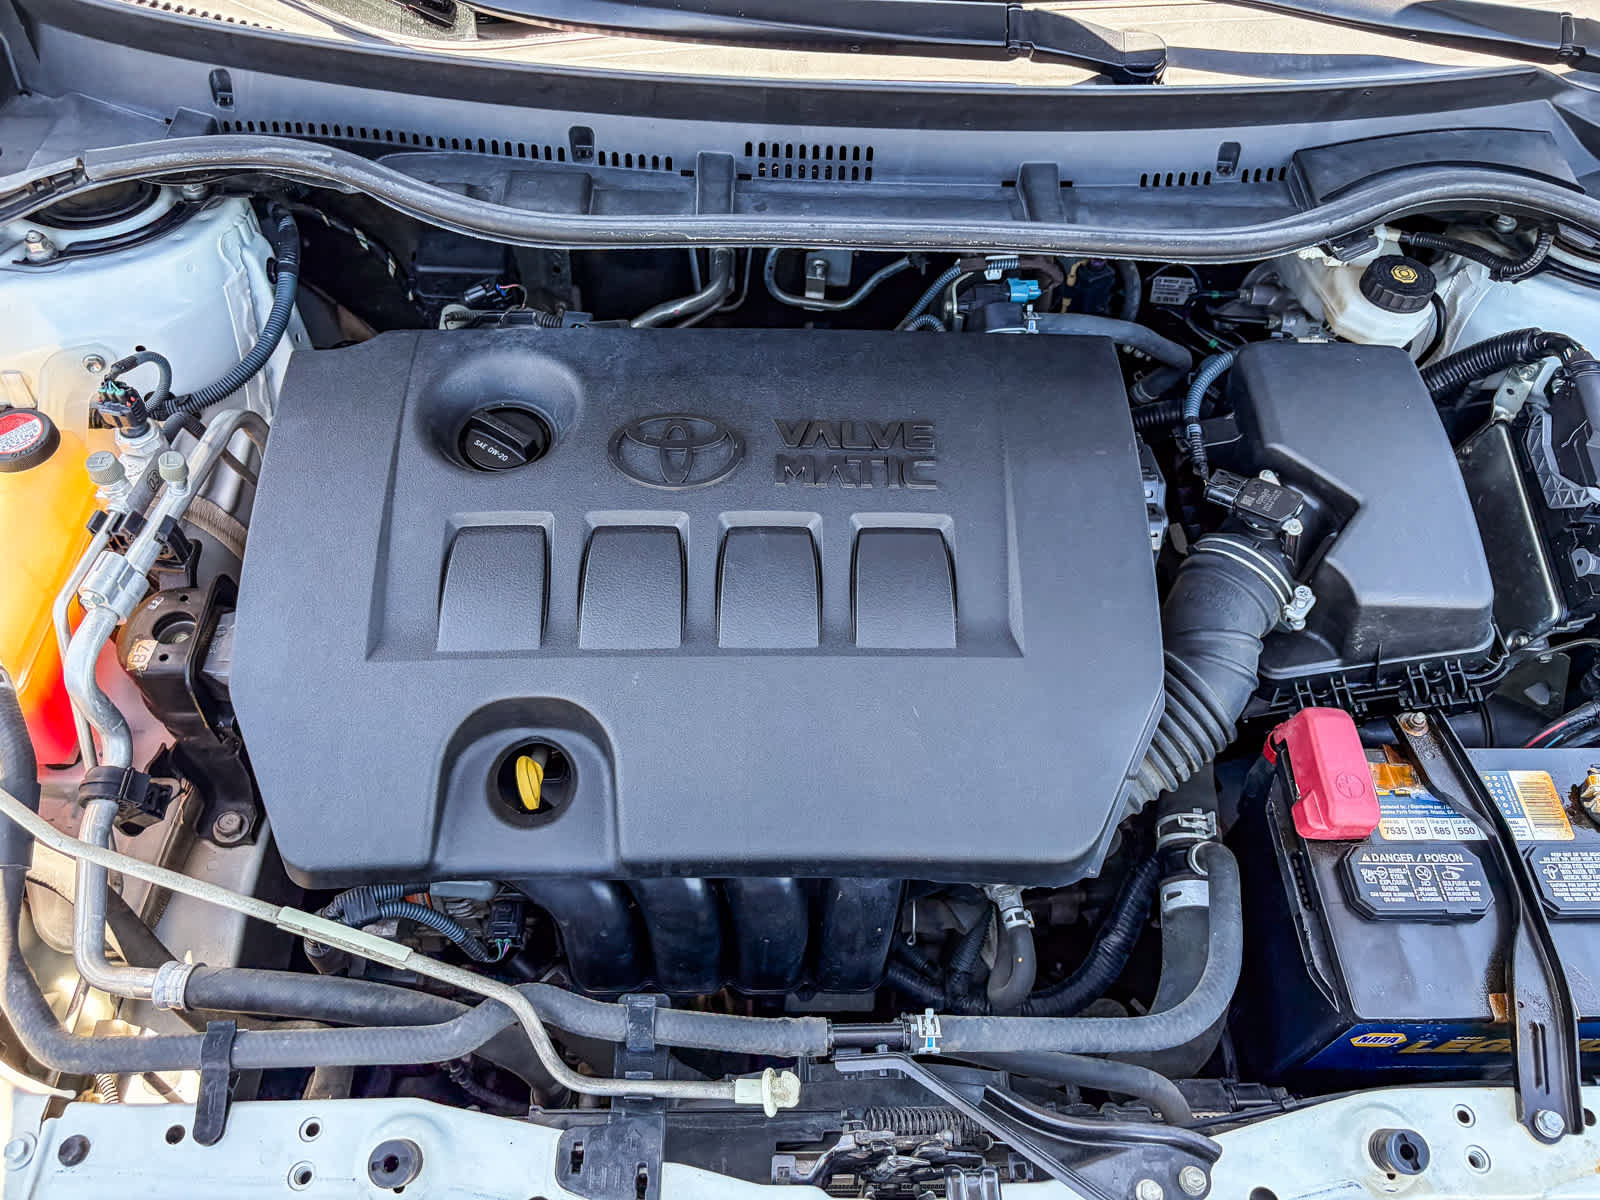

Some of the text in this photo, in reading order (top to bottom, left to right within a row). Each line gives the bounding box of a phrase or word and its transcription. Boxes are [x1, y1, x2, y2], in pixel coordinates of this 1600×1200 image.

[773, 419, 936, 449] VALVE
[474, 440, 488, 450] SAE
[775, 454, 937, 490] MATIC
[1384, 826, 1407, 835] 7535
[1415, 826, 1427, 835] 35
[1457, 826, 1476, 835] 550
[1371, 853, 1414, 862] DANGER
[1424, 853, 1463, 862] POISON
[1355, 1036, 1402, 1044] NAPA
